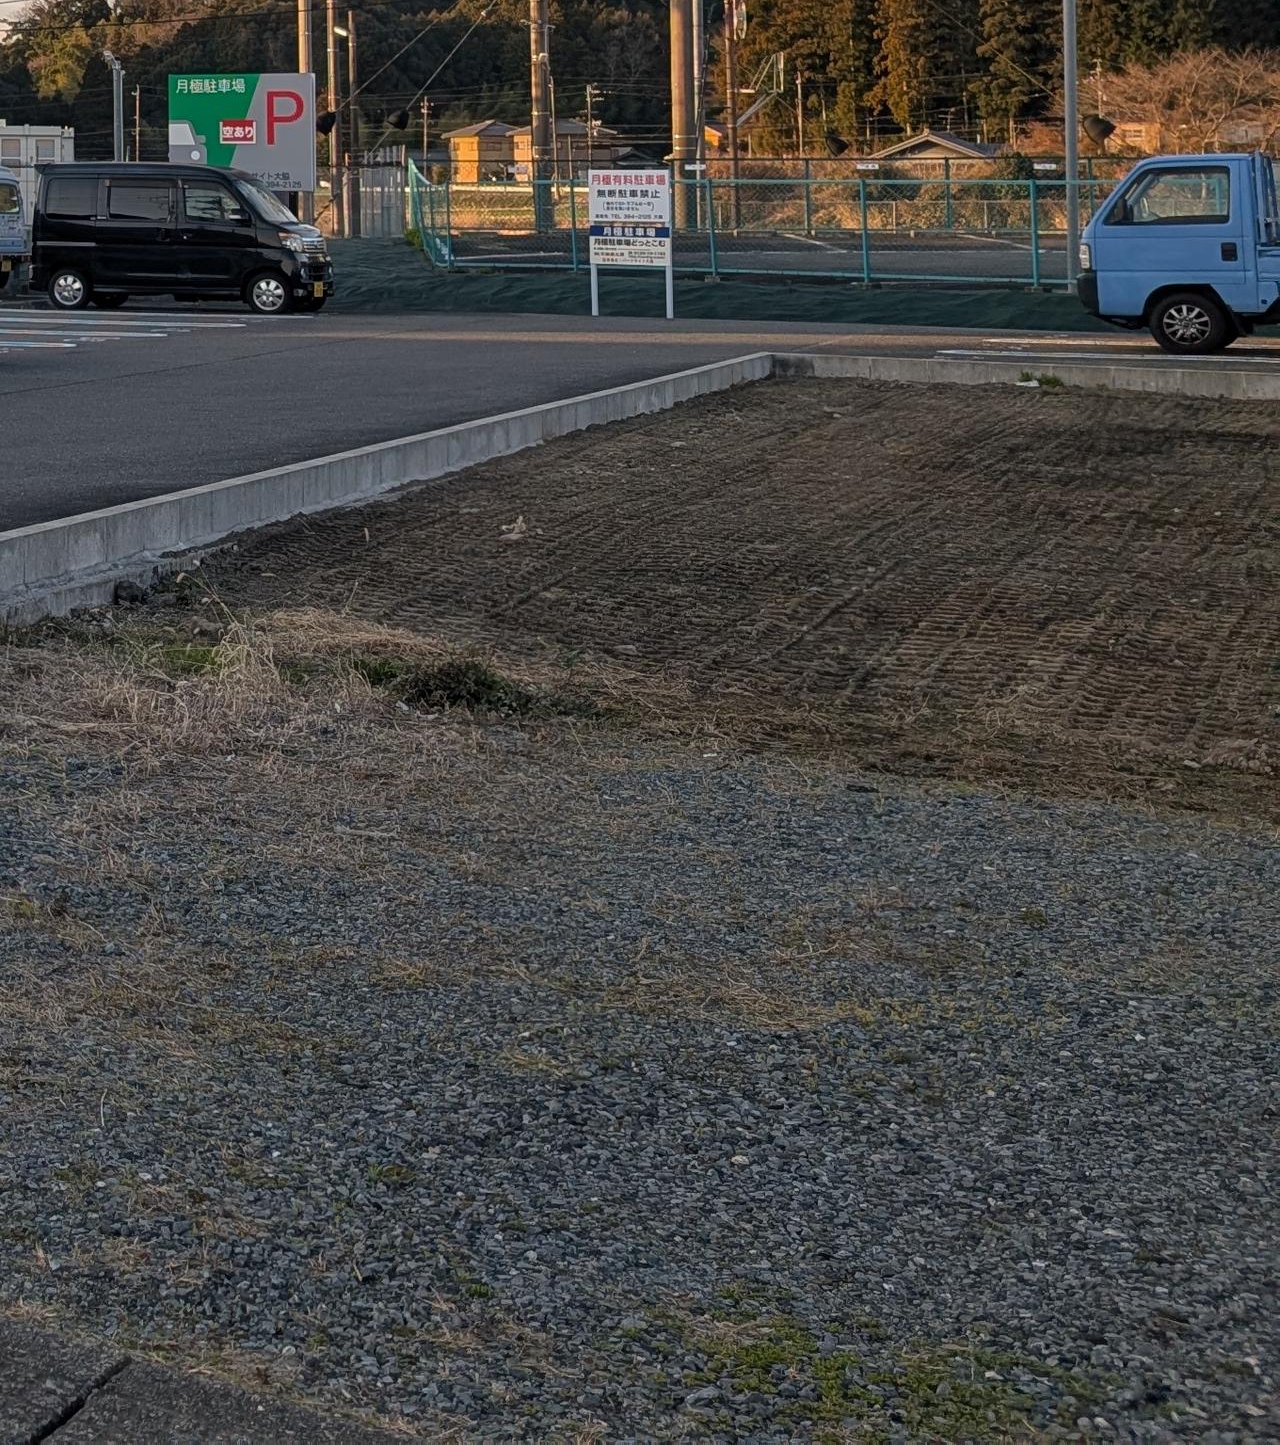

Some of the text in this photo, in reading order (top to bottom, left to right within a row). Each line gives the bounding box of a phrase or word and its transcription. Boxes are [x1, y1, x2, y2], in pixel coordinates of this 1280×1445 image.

[176, 79, 246, 94] 月極駐車場
[266, 90, 305, 146] P
[222, 126, 254, 138] 空あり
